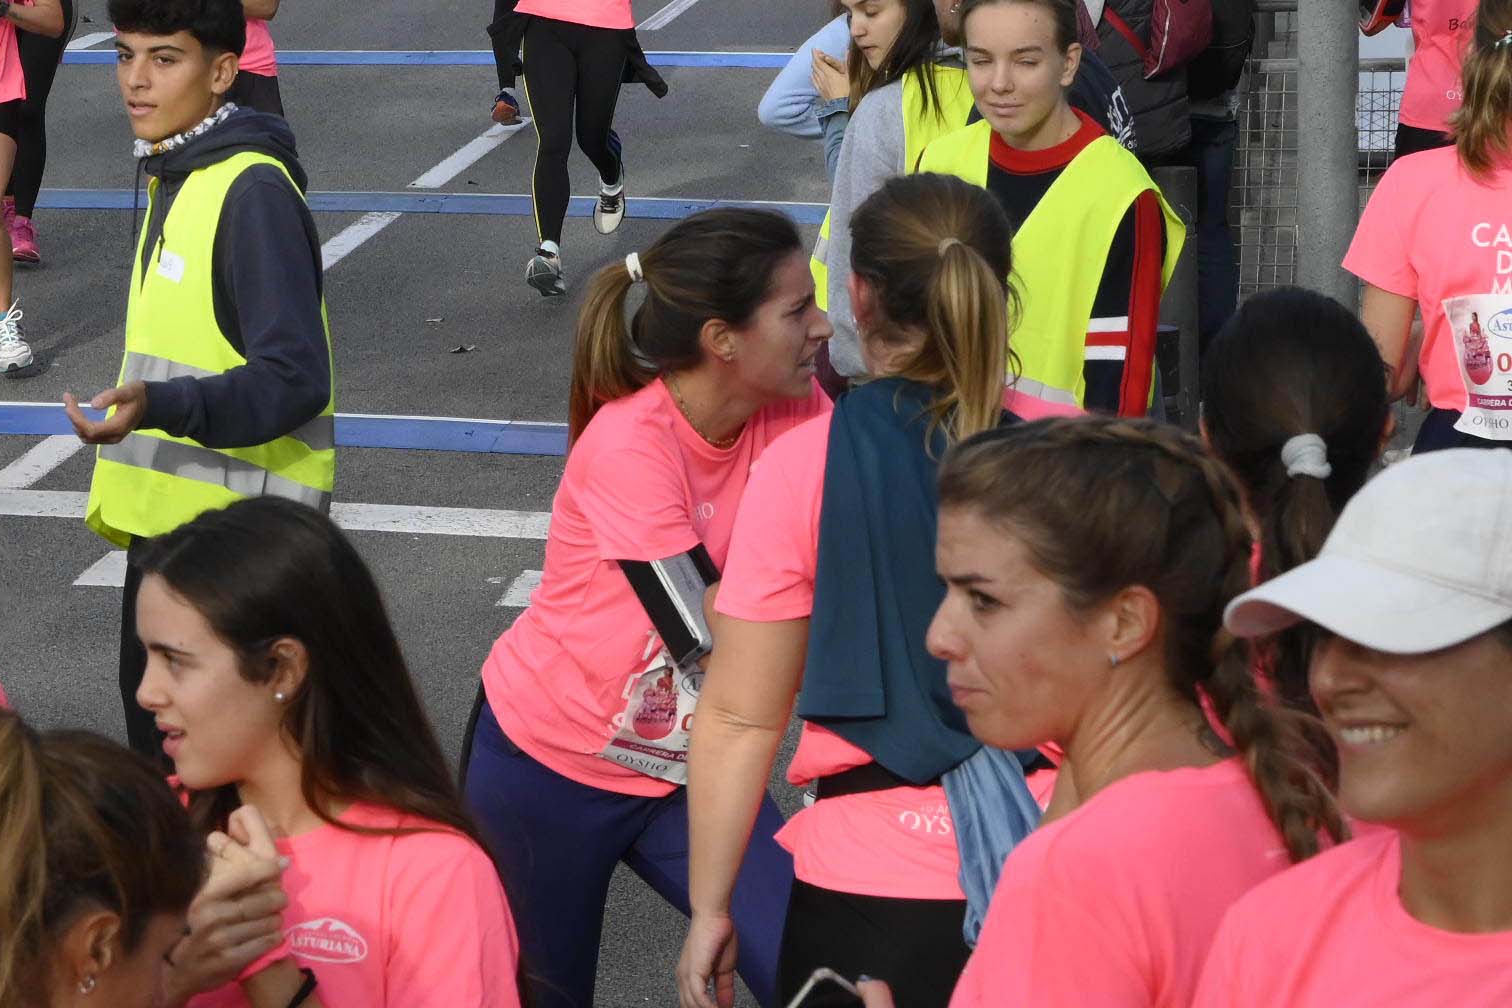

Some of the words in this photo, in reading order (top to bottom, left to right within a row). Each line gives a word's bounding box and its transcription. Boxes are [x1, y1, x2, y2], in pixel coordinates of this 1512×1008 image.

[629, 744, 676, 759] CARRERA
[616, 753, 668, 773] OYSHO
[899, 810, 951, 835] OYS
